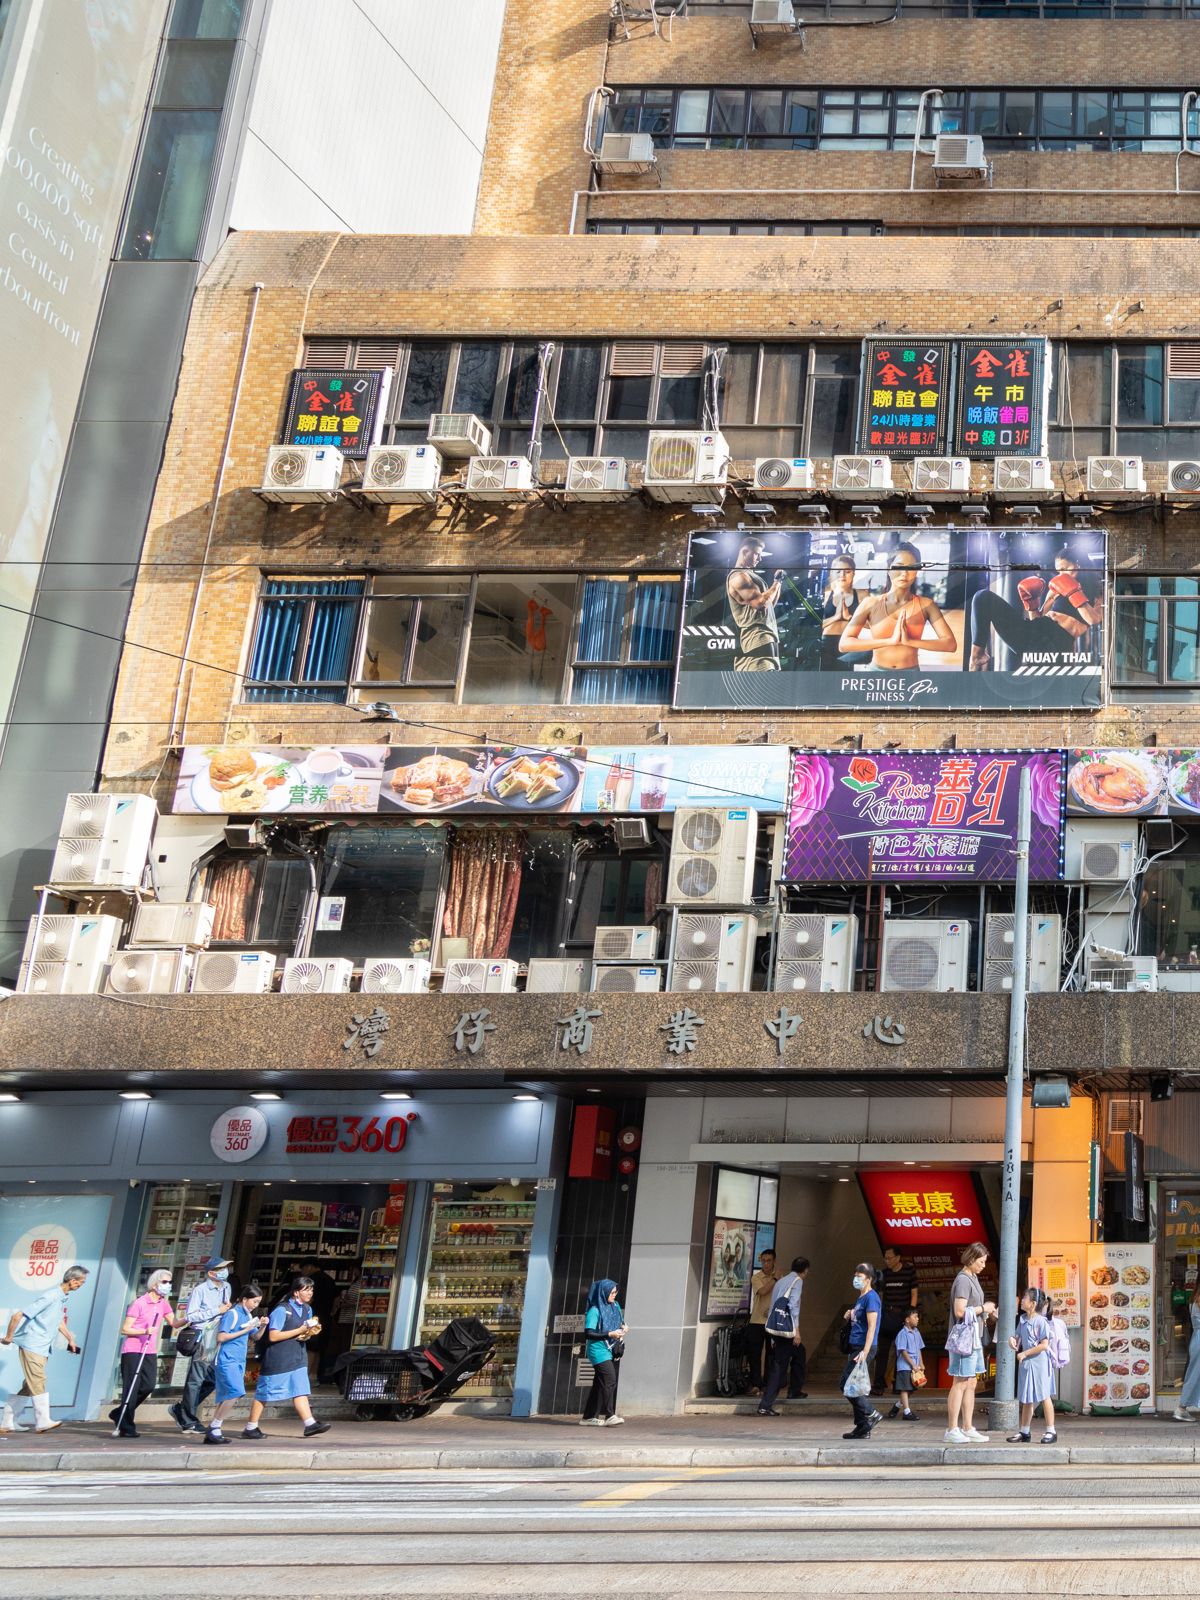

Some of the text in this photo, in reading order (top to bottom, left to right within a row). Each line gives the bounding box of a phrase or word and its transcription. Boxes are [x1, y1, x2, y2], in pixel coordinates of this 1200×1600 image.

[28, 127, 95, 205] Creating
[4, 145, 71, 216] 00,000
[16, 201, 75, 262] oasis in
[8, 232, 69, 296] Central
[876, 350, 916, 362] 中 發
[969, 349, 1031, 378] 金雀
[876, 363, 938, 386] 金雀
[303, 380, 318, 392] 中
[973, 384, 1025, 402] 午市
[305, 391, 357, 412] 金雀
[872, 389, 939, 409] 聯誼會
[297, 415, 362, 433] 聯誼會
[871, 413, 937, 427] 24小時營業
[968, 406, 1029, 425] 晚飯雀局
[343, 436, 359, 447] 3/F
[965, 430, 979, 445] 中
[1014, 430, 1030, 445] 3/F
[840, 543, 875, 555] YOGA
[707, 638, 736, 650] GYM
[1022, 652, 1091, 664] MUAY THAI
[841, 678, 939, 702] PRESTIGE Pro
[866, 692, 905, 702] FITNESS
[688, 760, 770, 777] SUMMER
[879, 770, 931, 800] Rose
[853, 791, 927, 826] Kitchen
[344, 1007, 907, 1057] 灣仔商業中心
[227, 1119, 252, 1131] 優品
[286, 1116, 337, 1143] 優品
[888, 1191, 958, 1214] 惠康
[885, 1216, 973, 1228] wellcome
[30, 1239, 59, 1254] 優品
